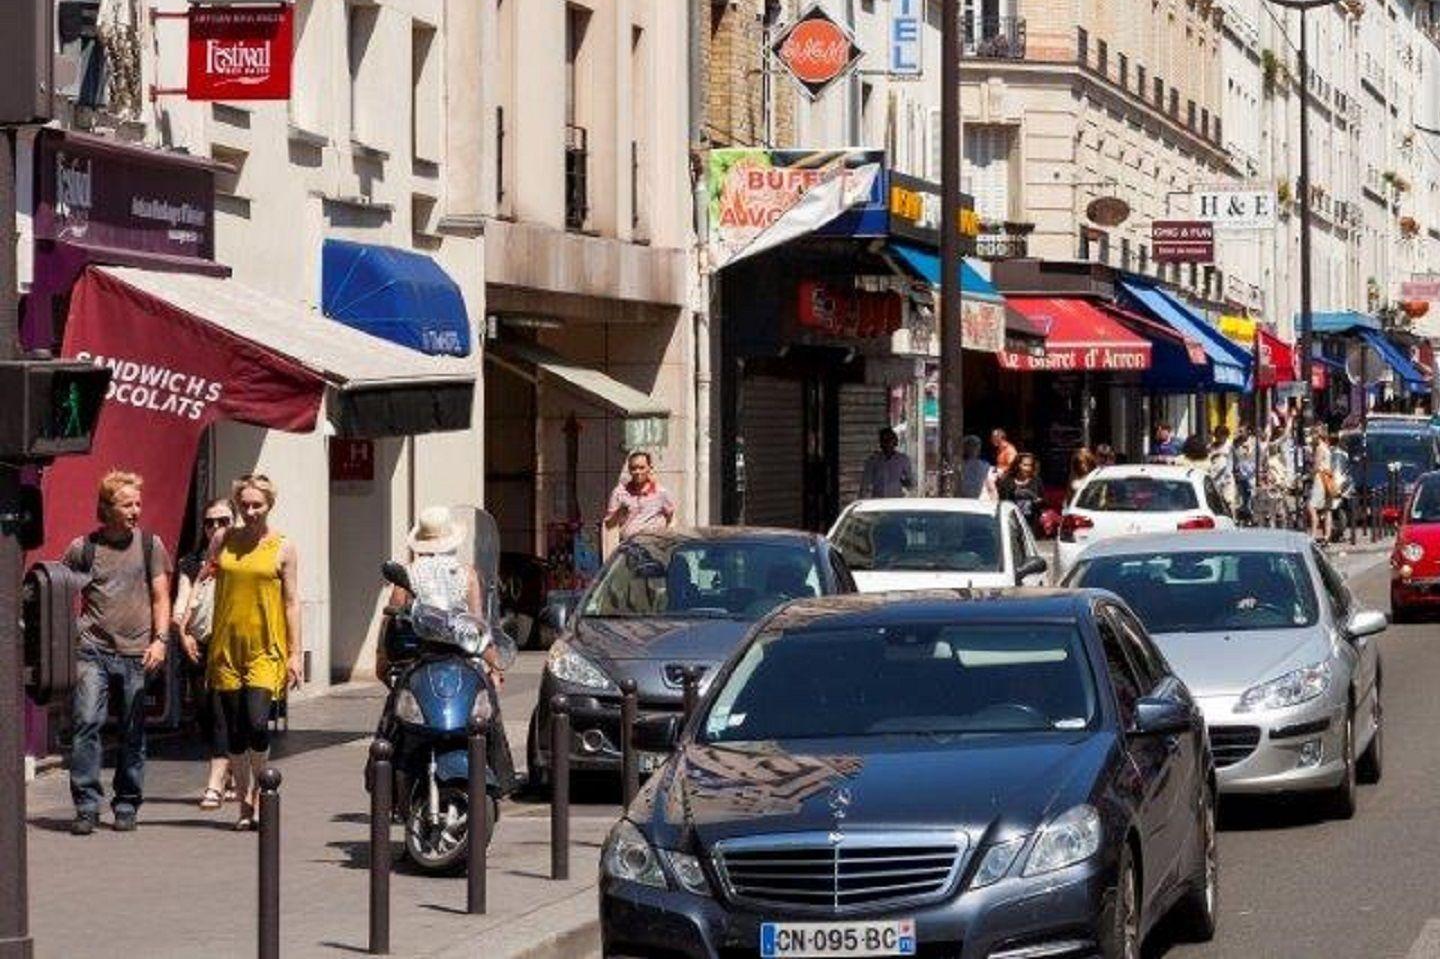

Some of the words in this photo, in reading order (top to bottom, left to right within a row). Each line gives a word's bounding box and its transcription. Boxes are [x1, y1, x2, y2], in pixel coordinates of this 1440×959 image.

[206, 40, 270, 73] Festival
[1201, 195, 1218, 215] H
[1227, 194, 1246, 216] &
[1254, 195, 1269, 215] E
[777, 927, 897, 951] CN-095-BC
